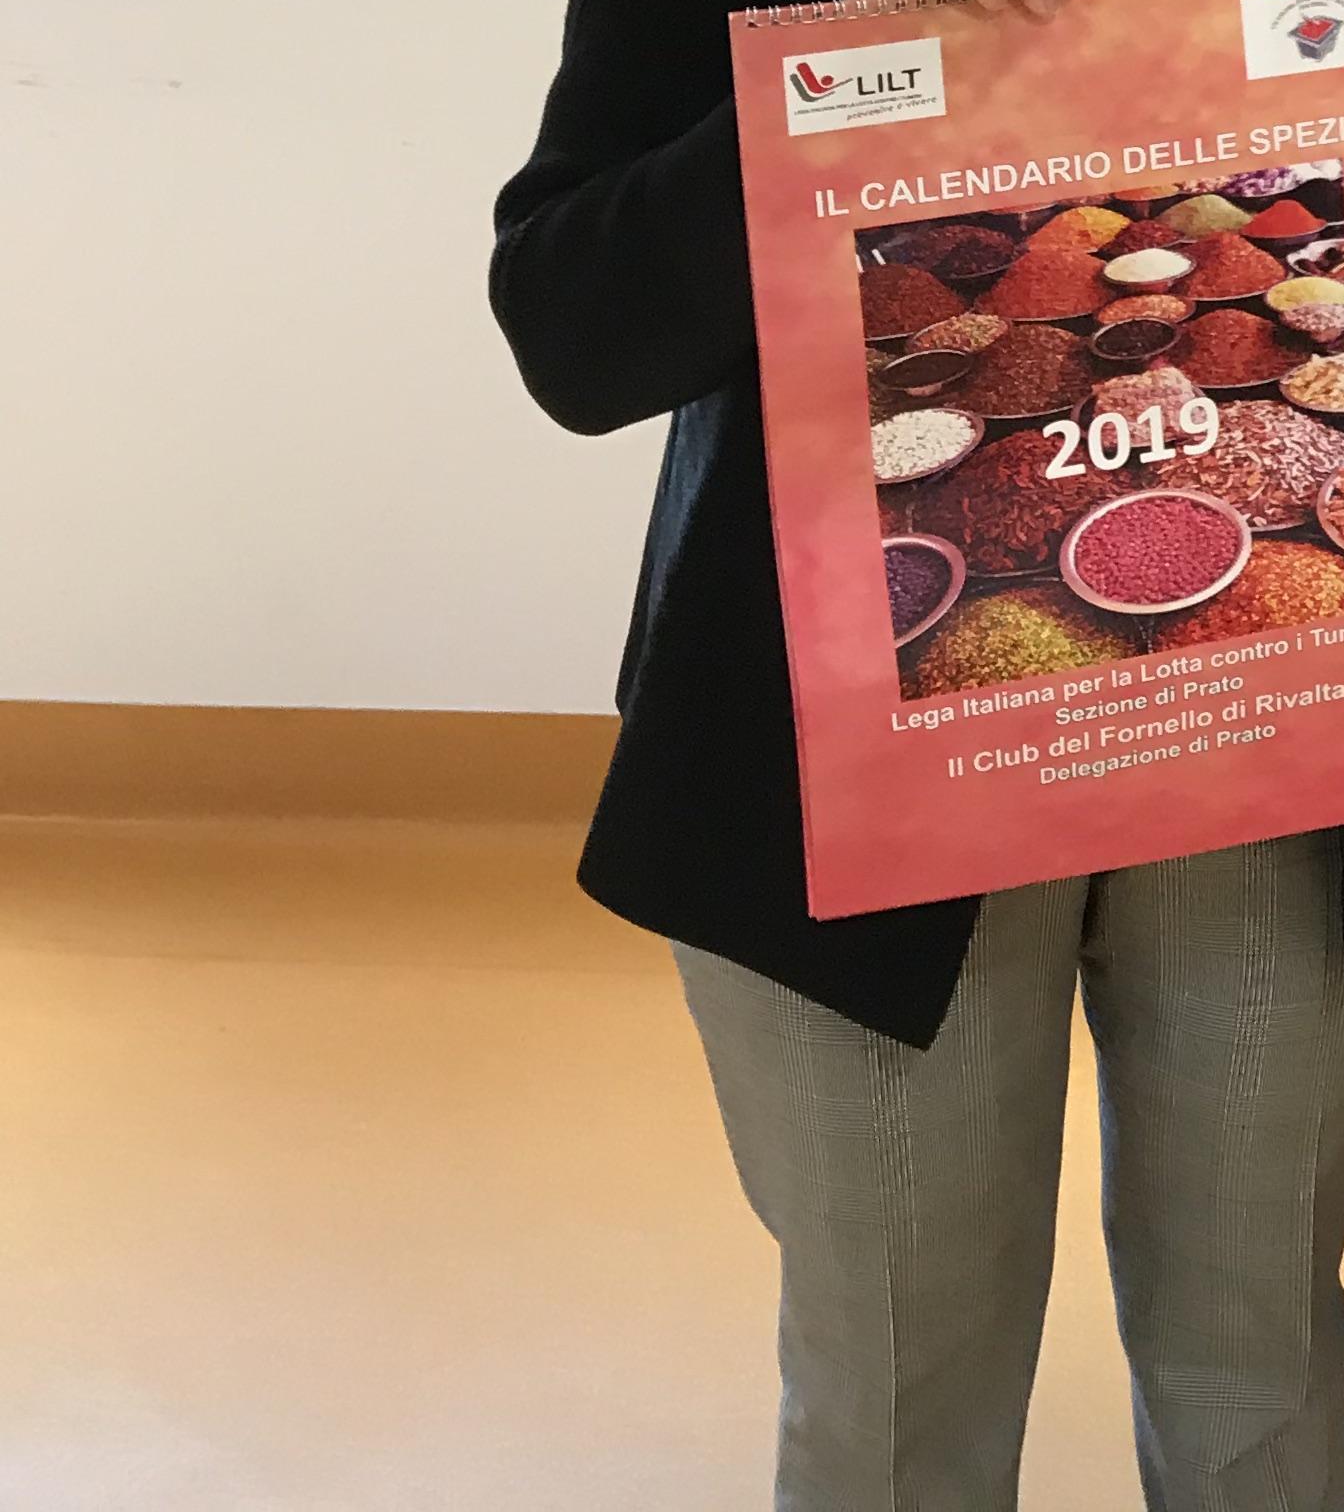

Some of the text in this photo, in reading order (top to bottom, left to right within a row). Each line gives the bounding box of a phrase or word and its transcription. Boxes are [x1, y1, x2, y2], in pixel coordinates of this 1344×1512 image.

[857, 68, 921, 95] LILT
[815, 188, 849, 218] IL
[860, 151, 1111, 211] CALENDARIO
[1123, 132, 1239, 174] DELLE
[1042, 396, 1220, 480] 2019
[891, 705, 955, 732] Lega
[962, 687, 1055, 717] Italiana
[1063, 675, 1104, 701] per
[1111, 669, 1132, 688] la
[1140, 656, 1202, 682] Lotta
[1210, 639, 1288, 668] contro
[1296, 633, 1303, 651] i
[1055, 675, 1244, 726] Sezione di Prato
[948, 756, 964, 778] Il
[973, 743, 1040, 773] Club
[1048, 732, 1090, 758] del
[1100, 710, 1213, 748] Fornello
[1222, 700, 1246, 722] di
[1040, 724, 1276, 785] Delegazione di Prato
